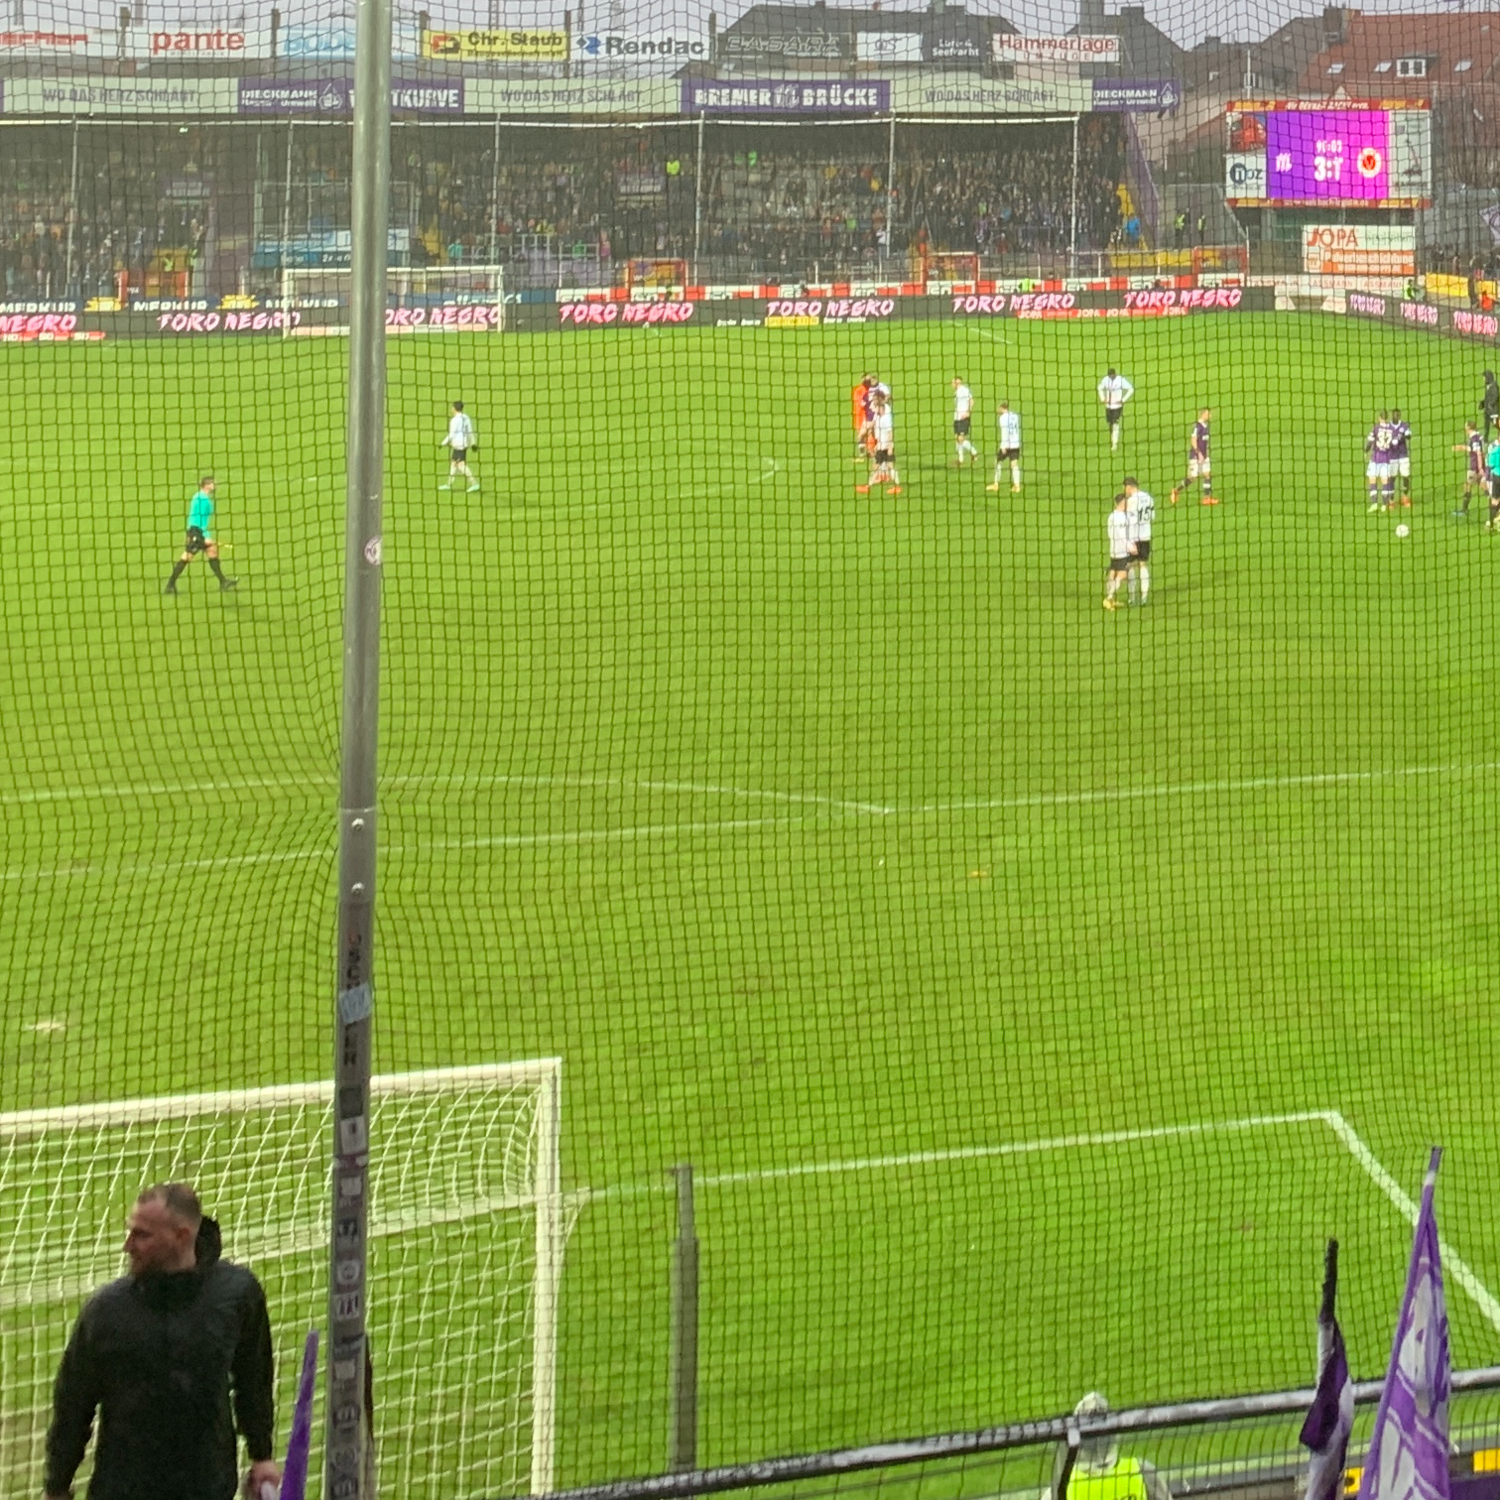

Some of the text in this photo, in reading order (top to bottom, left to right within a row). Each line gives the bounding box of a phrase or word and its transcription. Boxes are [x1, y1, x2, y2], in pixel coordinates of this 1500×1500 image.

[152, 29, 245, 55] pante
[468, 32, 563, 46] Chr. Staub
[605, 36, 705, 55] Rendac
[1000, 34, 1114, 53] Hammerlage
[694, 88, 771, 106] BREMER
[803, 85, 878, 106] BRÜCKE
[1307, 228, 1359, 247] JOPA
[767, 299, 895, 317] TORO NEGRO
[952, 293, 1075, 314] TORO NEGRO
[1123, 289, 1243, 308] TORO NEGRO
[156, 312, 220, 333] TORO
[385, 306, 501, 326] ORO NEGRO
[559, 302, 618, 324] TORO
[621, 302, 694, 323] NEGRO
